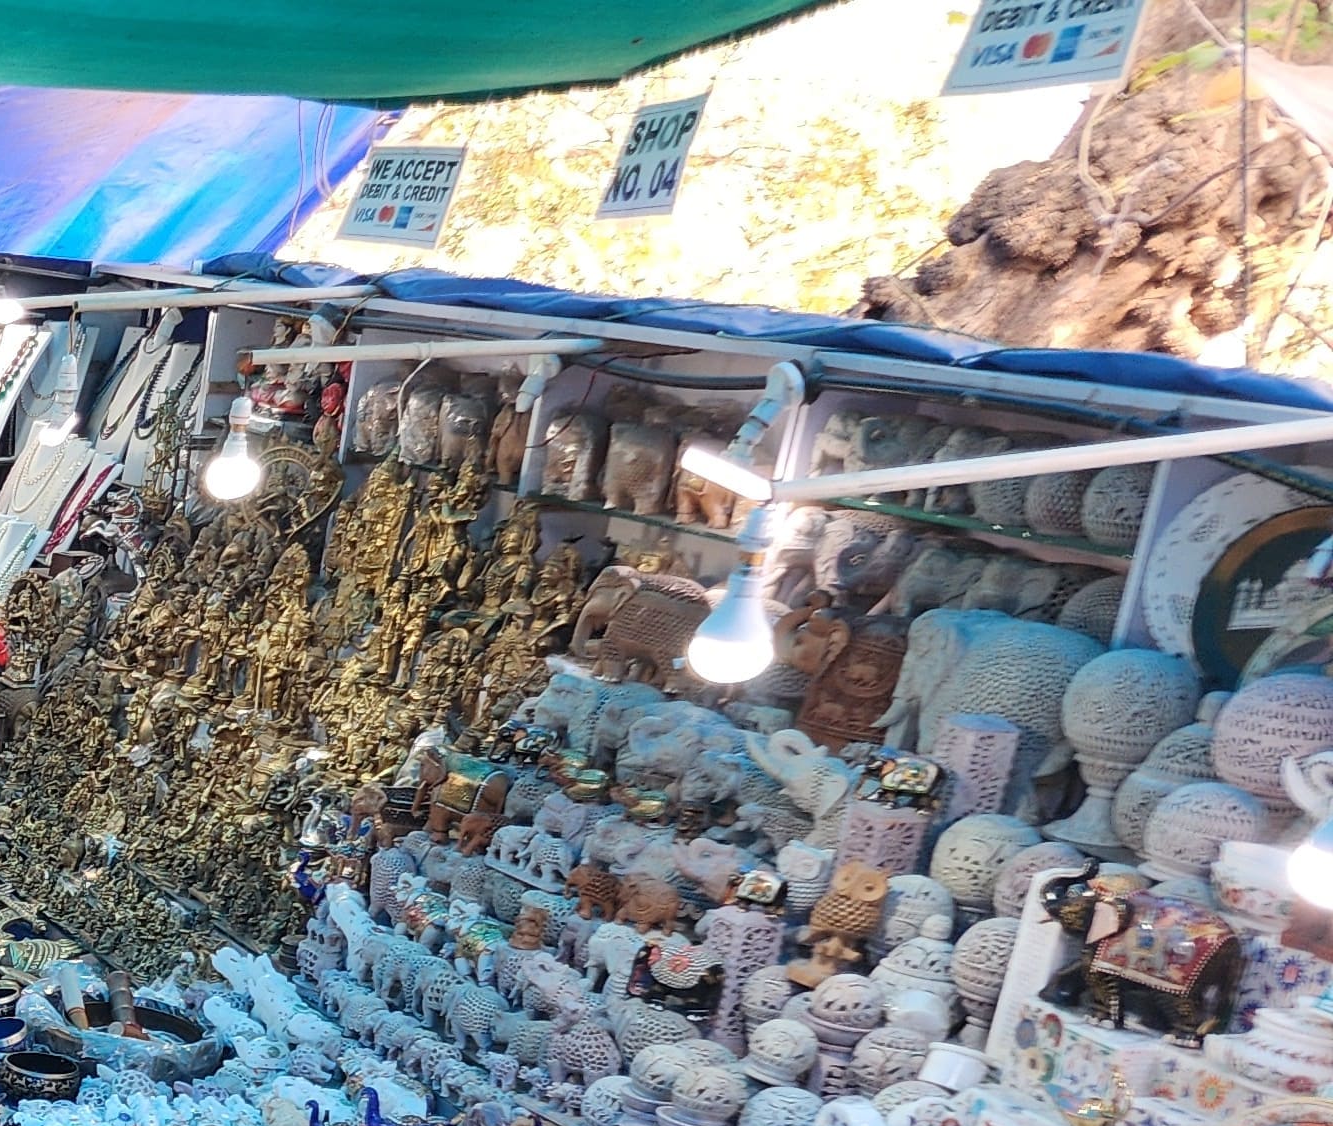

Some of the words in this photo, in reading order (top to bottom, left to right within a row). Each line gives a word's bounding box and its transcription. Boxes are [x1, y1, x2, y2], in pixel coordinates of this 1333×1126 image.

[979, 2, 1045, 33] DEBIT
[970, 41, 1019, 68] VISA
[625, 110, 698, 156] SHOP
[368, 160, 394, 180] WE
[393, 160, 459, 182] ACCEPT
[603, 163, 642, 204] NO.
[648, 156, 681, 198] 04
[360, 184, 393, 200] DEBIT
[392, 184, 402, 200] &
[403, 184, 451, 203] CREDIT
[353, 208, 377, 222] VISA
